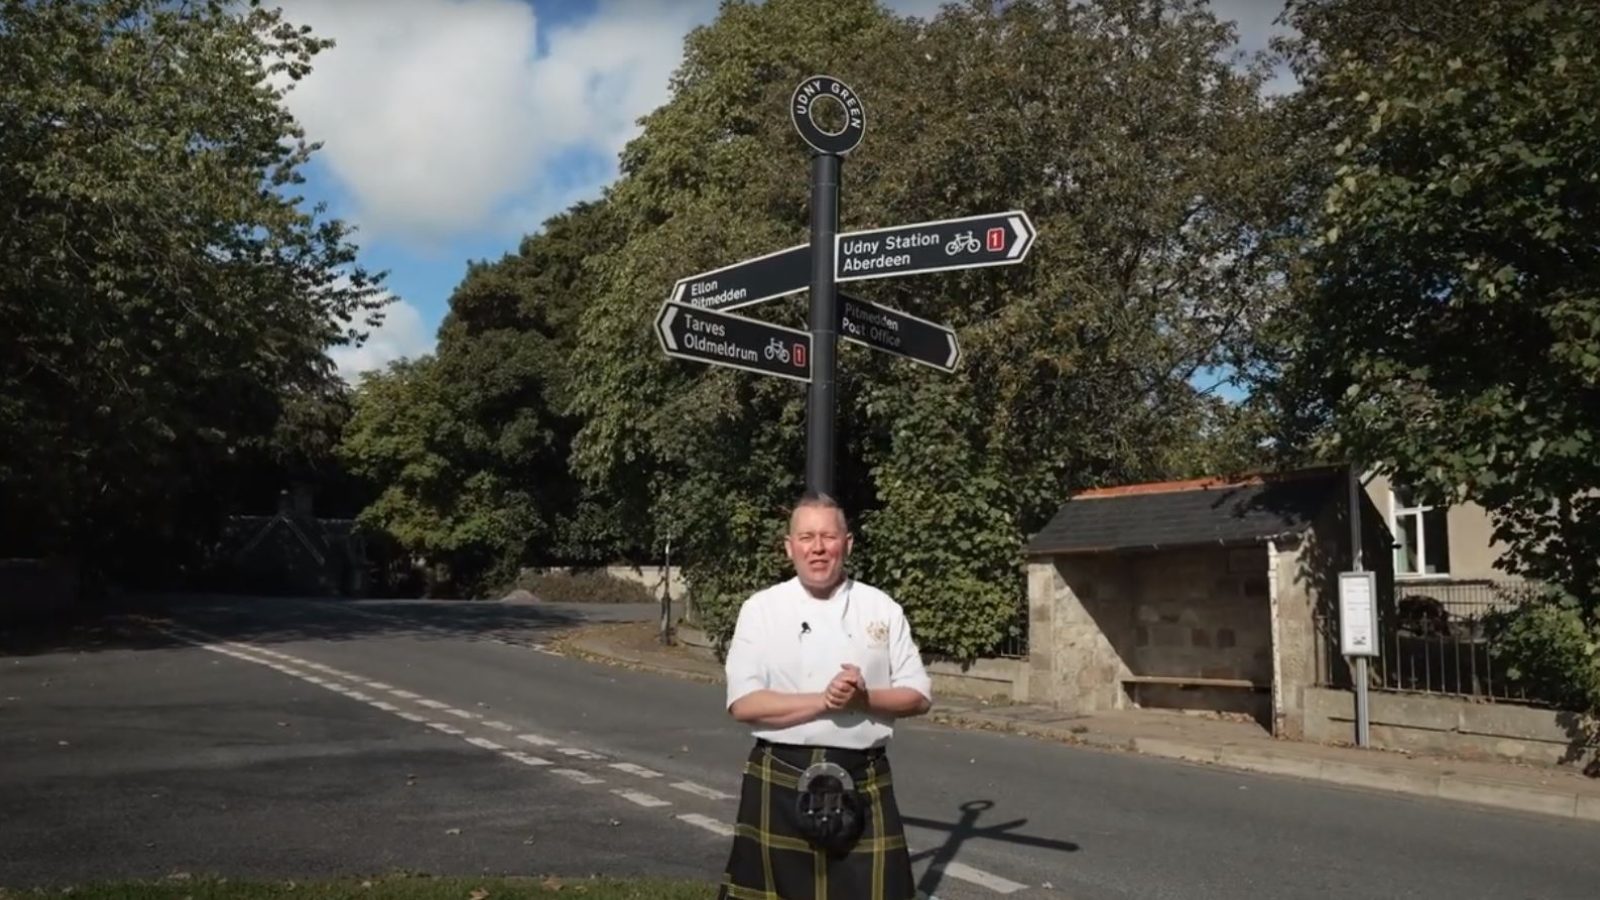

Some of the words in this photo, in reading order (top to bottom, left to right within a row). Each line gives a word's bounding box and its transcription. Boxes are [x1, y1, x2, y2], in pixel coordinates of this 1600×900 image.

[796, 80, 821, 114] UDNY
[831, 83, 862, 129] GREEN
[843, 241, 879, 256] Udny
[886, 233, 939, 250] Station
[991, 233, 998, 247] 1
[843, 255, 911, 271] Aberdeen
[691, 287, 747, 308] Pitmedden
[692, 280, 718, 296] Ellon
[684, 314, 725, 336] Tarves
[845, 303, 899, 331] Pitmedden
[842, 318, 867, 335] Post
[870, 327, 901, 347] Office
[684, 335, 758, 362] Oldmeldrum
[797, 348, 803, 362] 1
